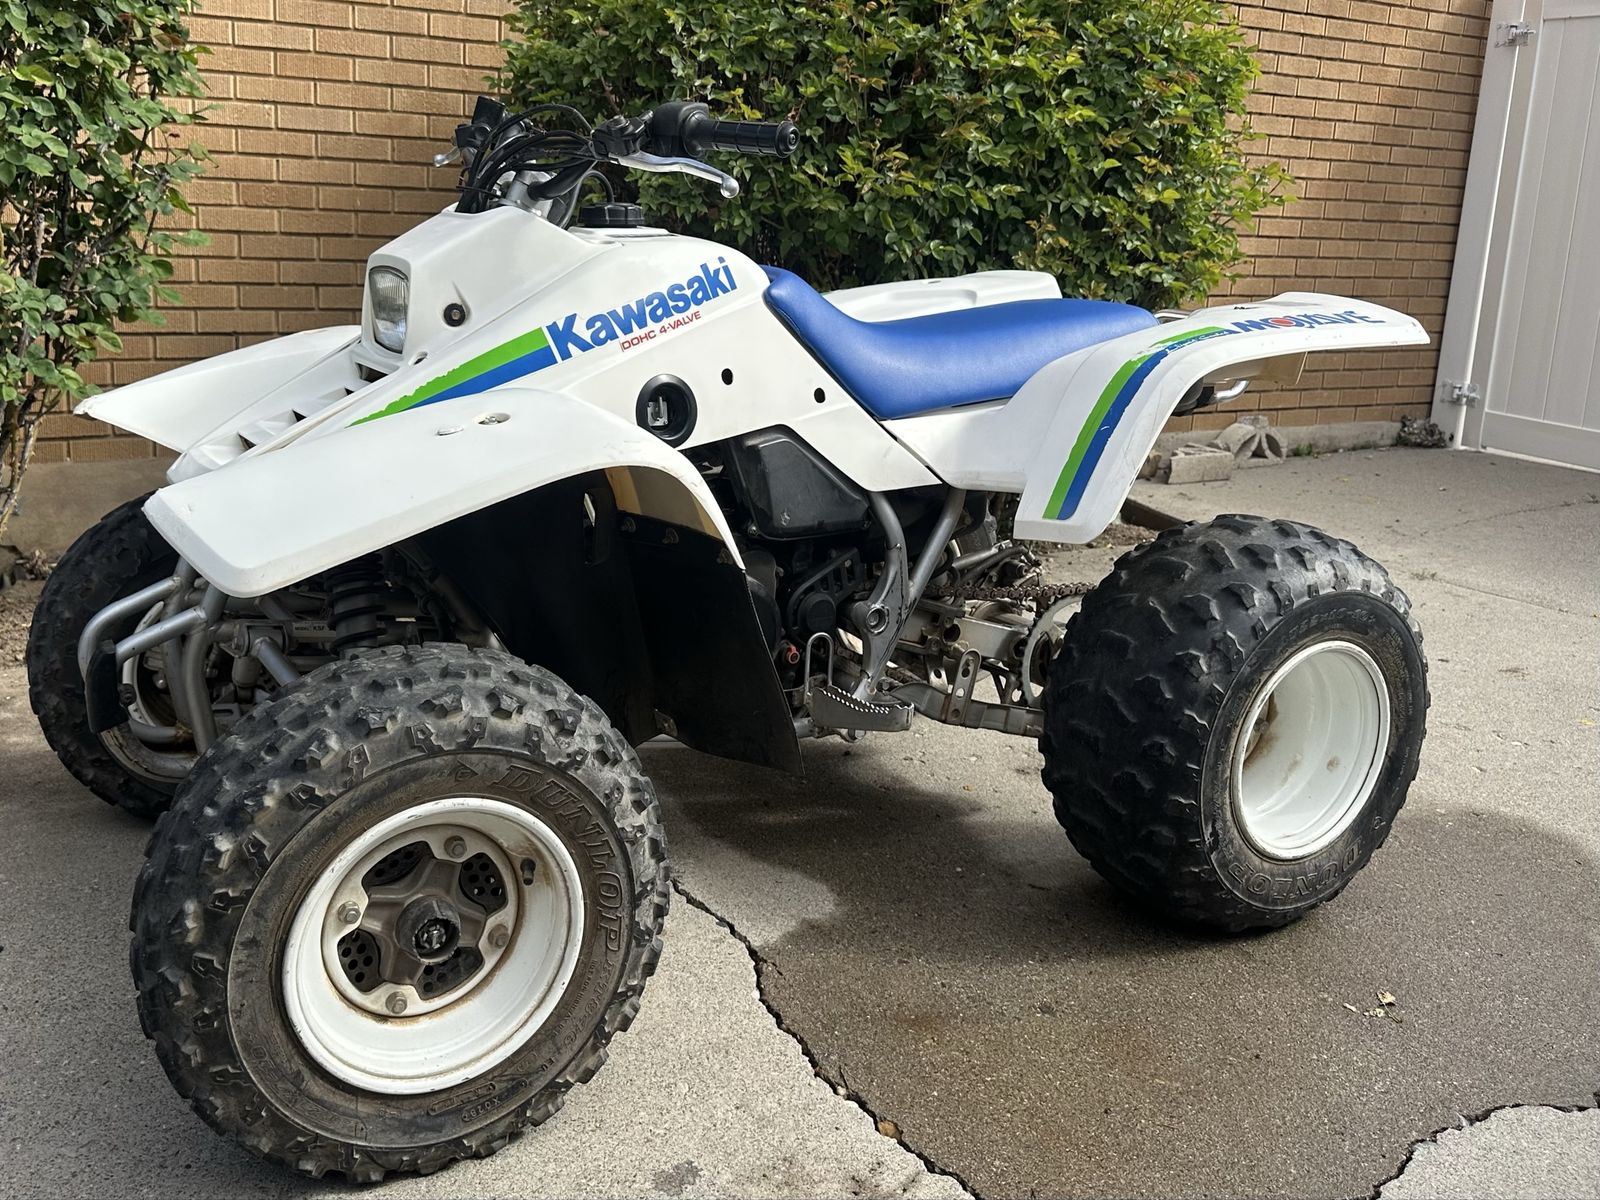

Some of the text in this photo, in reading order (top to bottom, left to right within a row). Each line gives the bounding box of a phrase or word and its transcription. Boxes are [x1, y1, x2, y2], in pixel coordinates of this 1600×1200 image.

[546, 256, 738, 362] Kawasaki
[622, 310, 702, 351] DOHC 4-VALVE
[1231, 311, 1386, 333] MOJAVE
[487, 764, 624, 951] DUNLOP
[1228, 839, 1363, 899] DUNLOP
